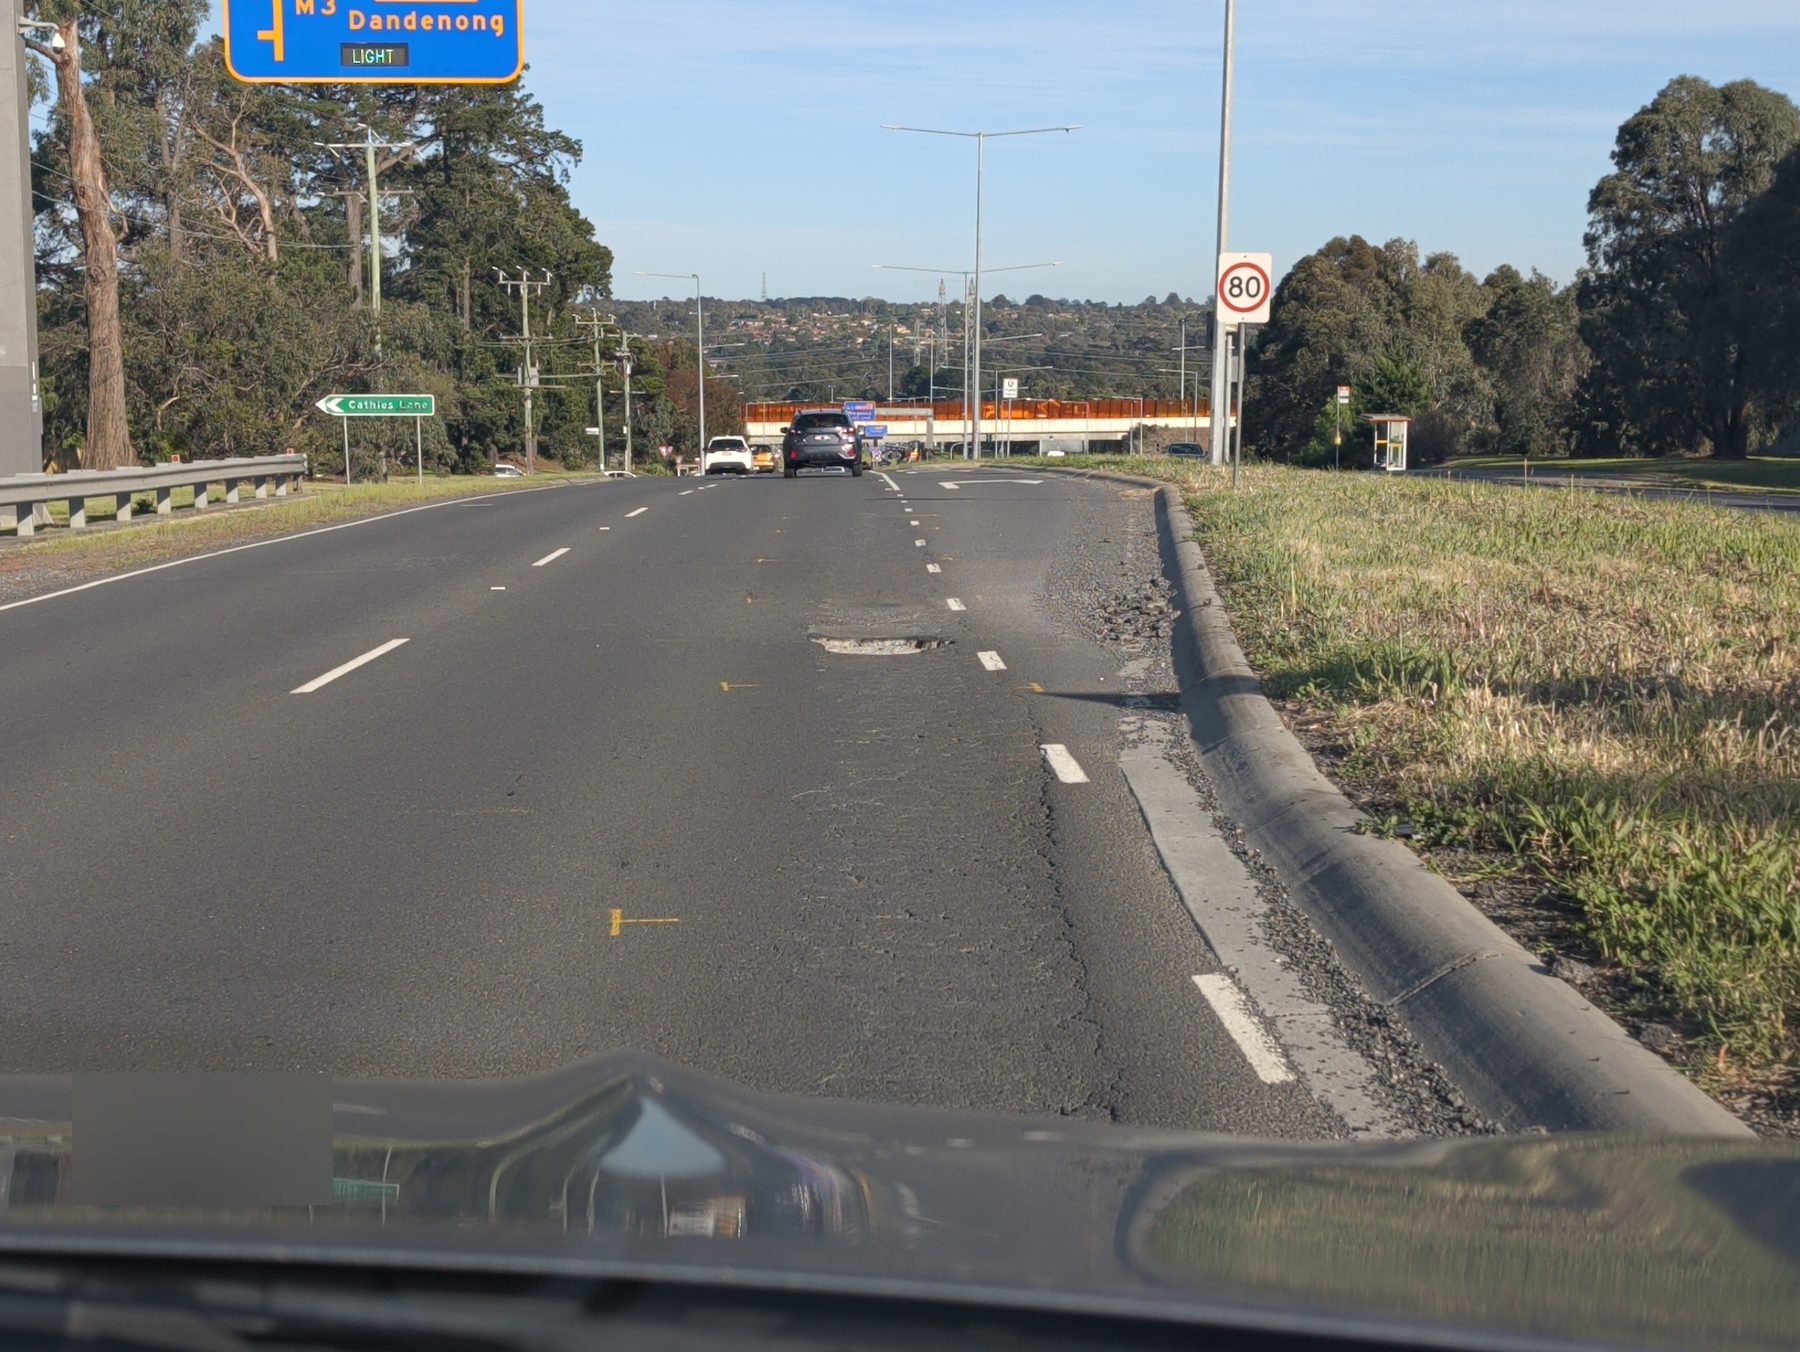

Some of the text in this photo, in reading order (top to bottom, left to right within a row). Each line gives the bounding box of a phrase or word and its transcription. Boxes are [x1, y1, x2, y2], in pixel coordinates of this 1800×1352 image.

[348, 10, 505, 37] Dandenong
[352, 48, 394, 64] LIGHT
[1229, 276, 1261, 298] 80
[348, 400, 428, 410] Cathies Lane
